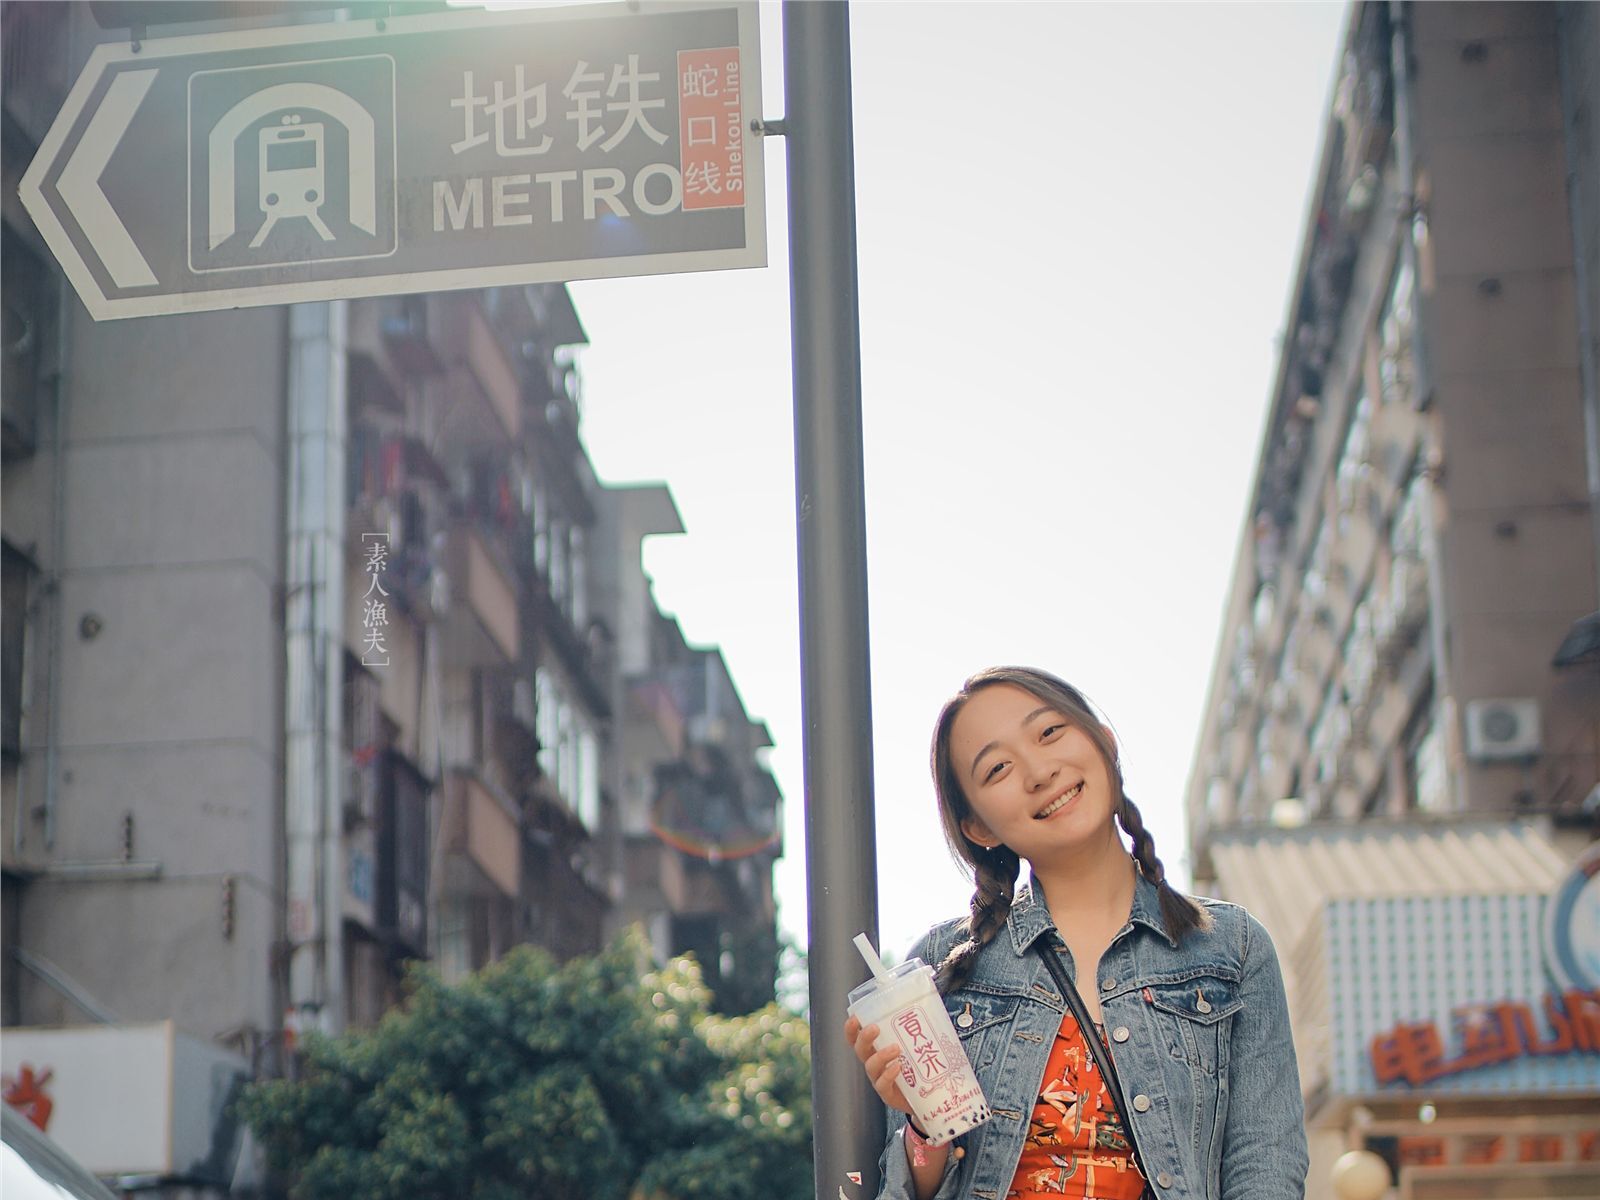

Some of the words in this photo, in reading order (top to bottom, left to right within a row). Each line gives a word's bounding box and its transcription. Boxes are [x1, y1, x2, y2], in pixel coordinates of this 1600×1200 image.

[450, 54, 669, 157] 地铁
[723, 61, 740, 106] Line
[682, 63, 722, 195] 蛇口线
[725, 111, 742, 192] Shekou
[432, 163, 682, 232] METRO
